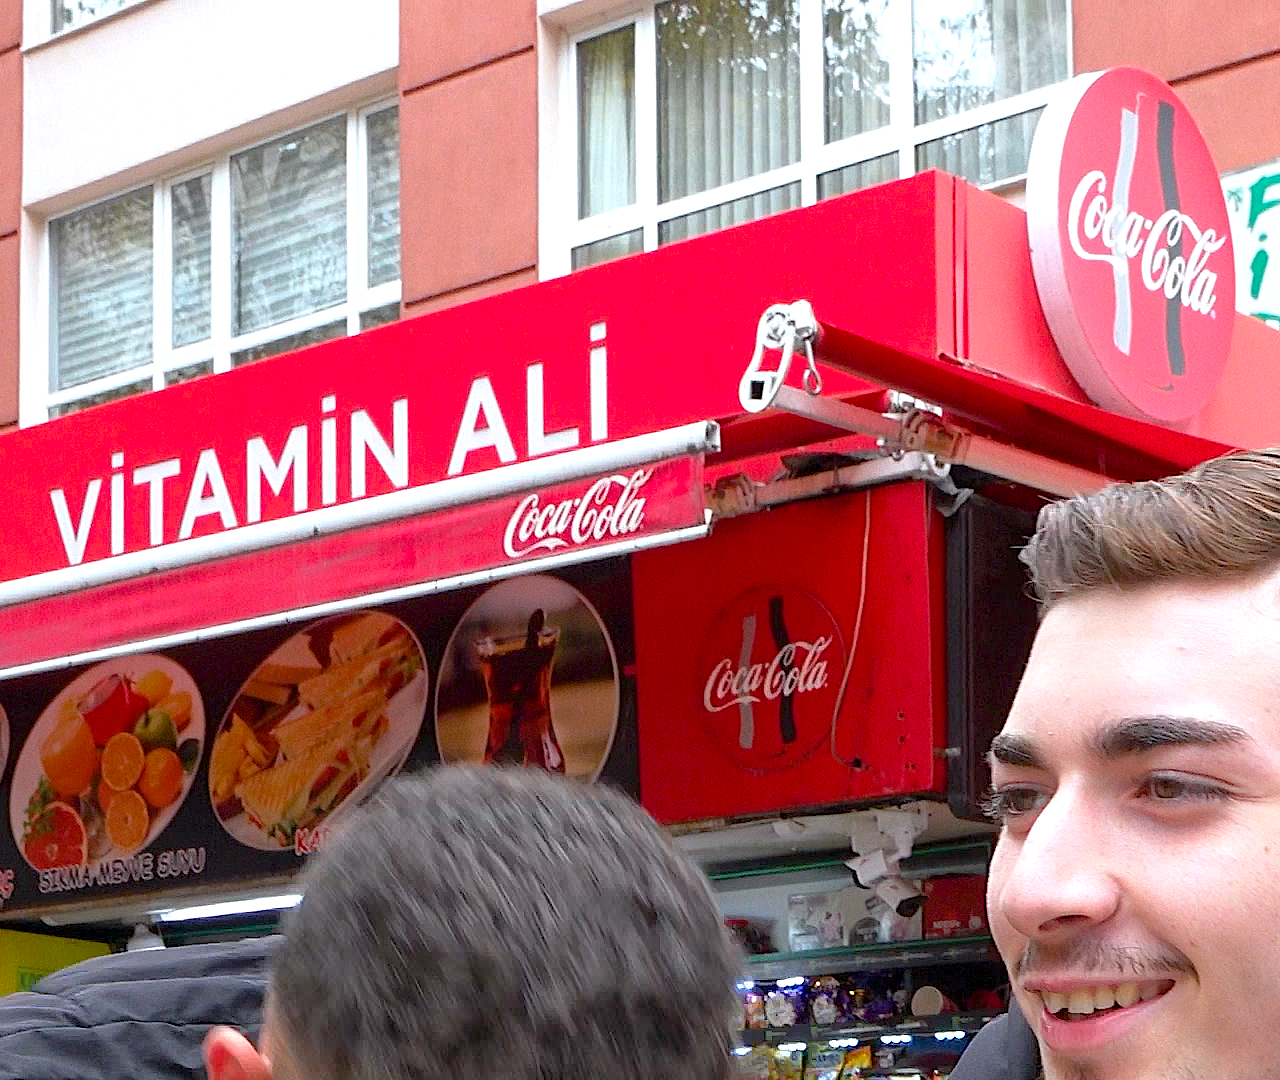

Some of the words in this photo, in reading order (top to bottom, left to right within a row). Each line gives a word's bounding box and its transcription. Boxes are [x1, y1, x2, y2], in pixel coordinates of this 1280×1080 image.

[1067, 171, 1227, 318] Coca-Cola
[50, 394, 409, 566] VİTAMİN
[447, 322, 608, 476] ALİ
[503, 466, 653, 559] Coca-Cola
[703, 634, 834, 714] Coca-Cola
